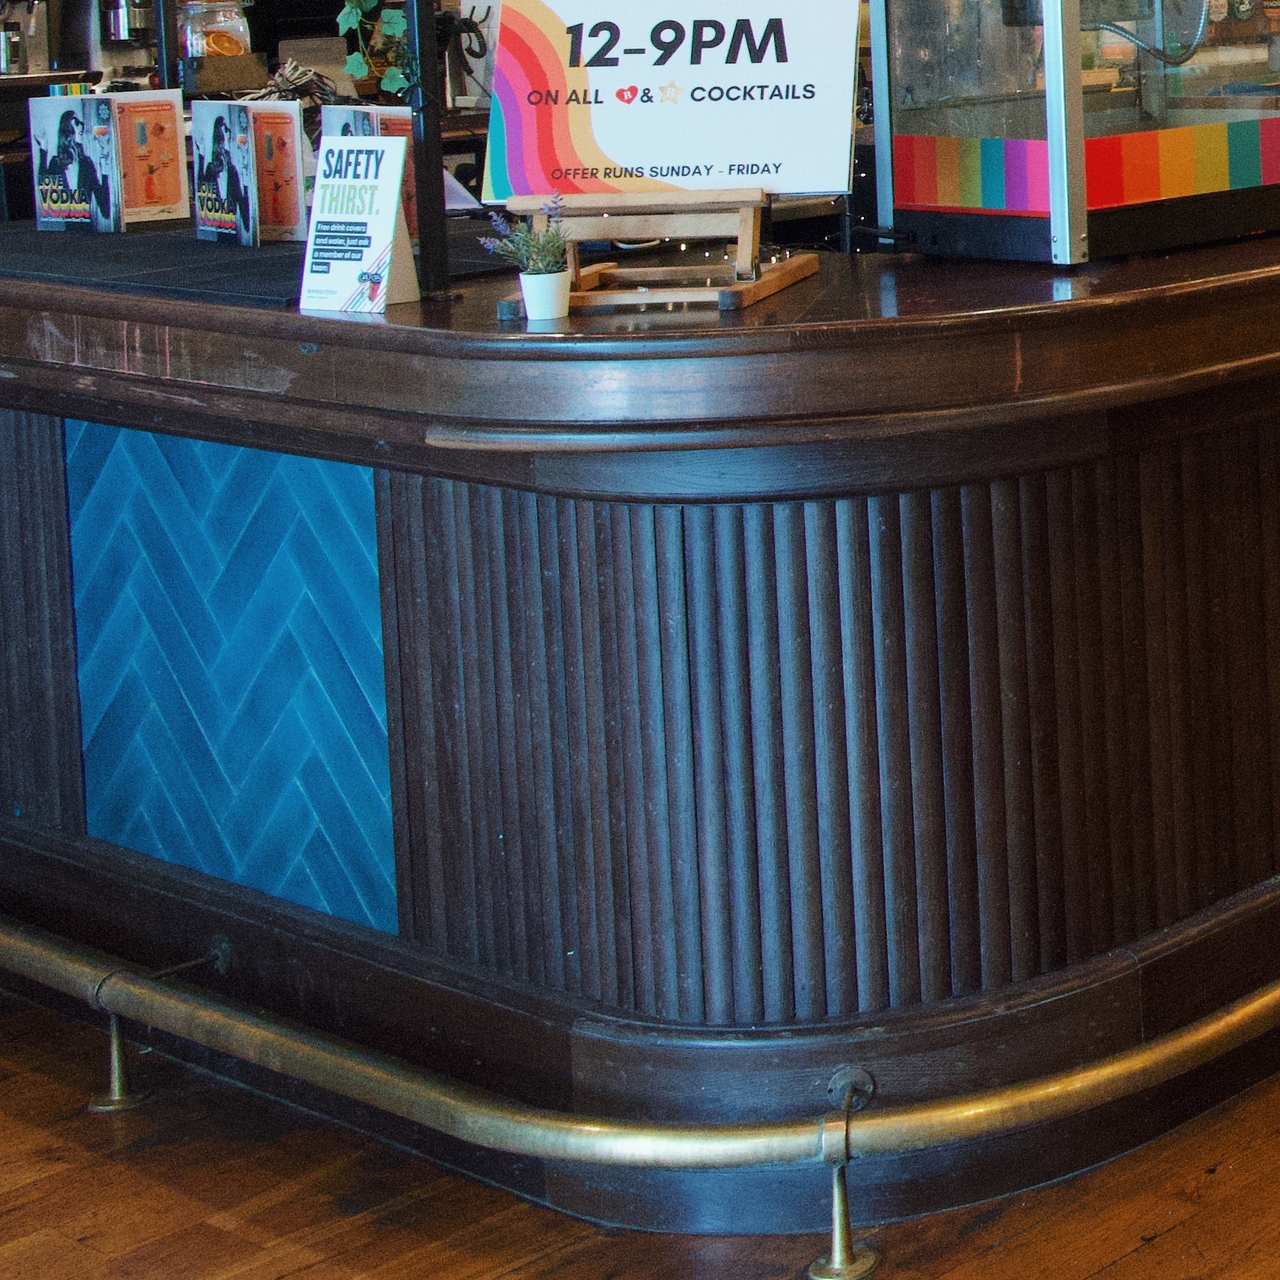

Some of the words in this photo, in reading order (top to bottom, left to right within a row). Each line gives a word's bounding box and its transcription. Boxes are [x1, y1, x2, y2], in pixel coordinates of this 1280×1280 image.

[565, 18, 789, 68] 12-9PM
[526, 90, 560, 106] ON
[565, 88, 604, 106] ALL
[640, 89, 654, 104] &
[690, 83, 816, 103] COCKTAILS
[323, 149, 385, 180] SAFETY
[551, 167, 599, 181] OFFER
[603, 166, 644, 179] RUNS
[648, 164, 714, 178] SUNDAY
[728, 163, 783, 176] FRIDAY
[38, 175, 63, 189] LOVE
[197, 182, 217, 196] LOVE
[40, 189, 90, 205] VODKA
[198, 196, 237, 214] VODKA
[319, 184, 380, 216] THIRST.
[330, 223, 345, 233] drink
[315, 236, 326, 245] and
[319, 249, 344, 259] member
